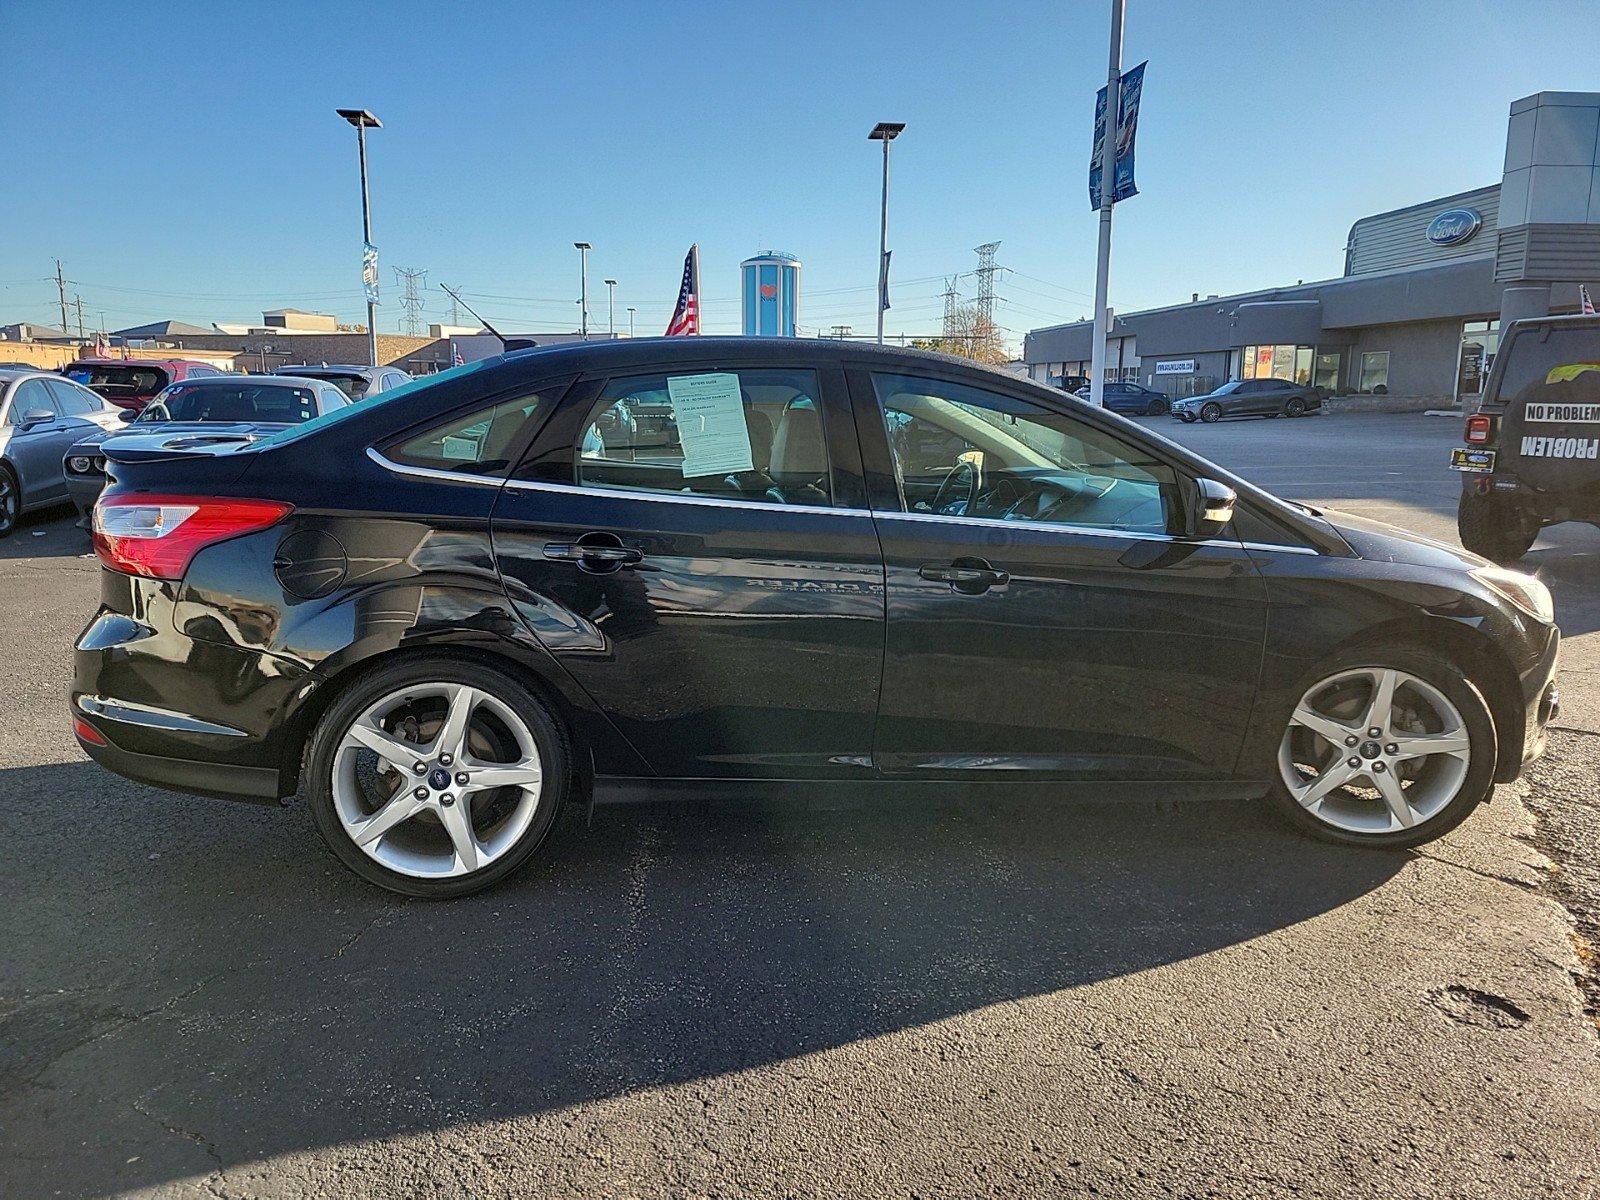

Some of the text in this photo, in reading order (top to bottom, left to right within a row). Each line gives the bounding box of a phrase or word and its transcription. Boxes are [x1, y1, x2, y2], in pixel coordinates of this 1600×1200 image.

[1433, 217, 1464, 239] Ford
[1527, 405, 1600, 421] NO PROBLEM
[1520, 436, 1599, 459] PROBLEM
